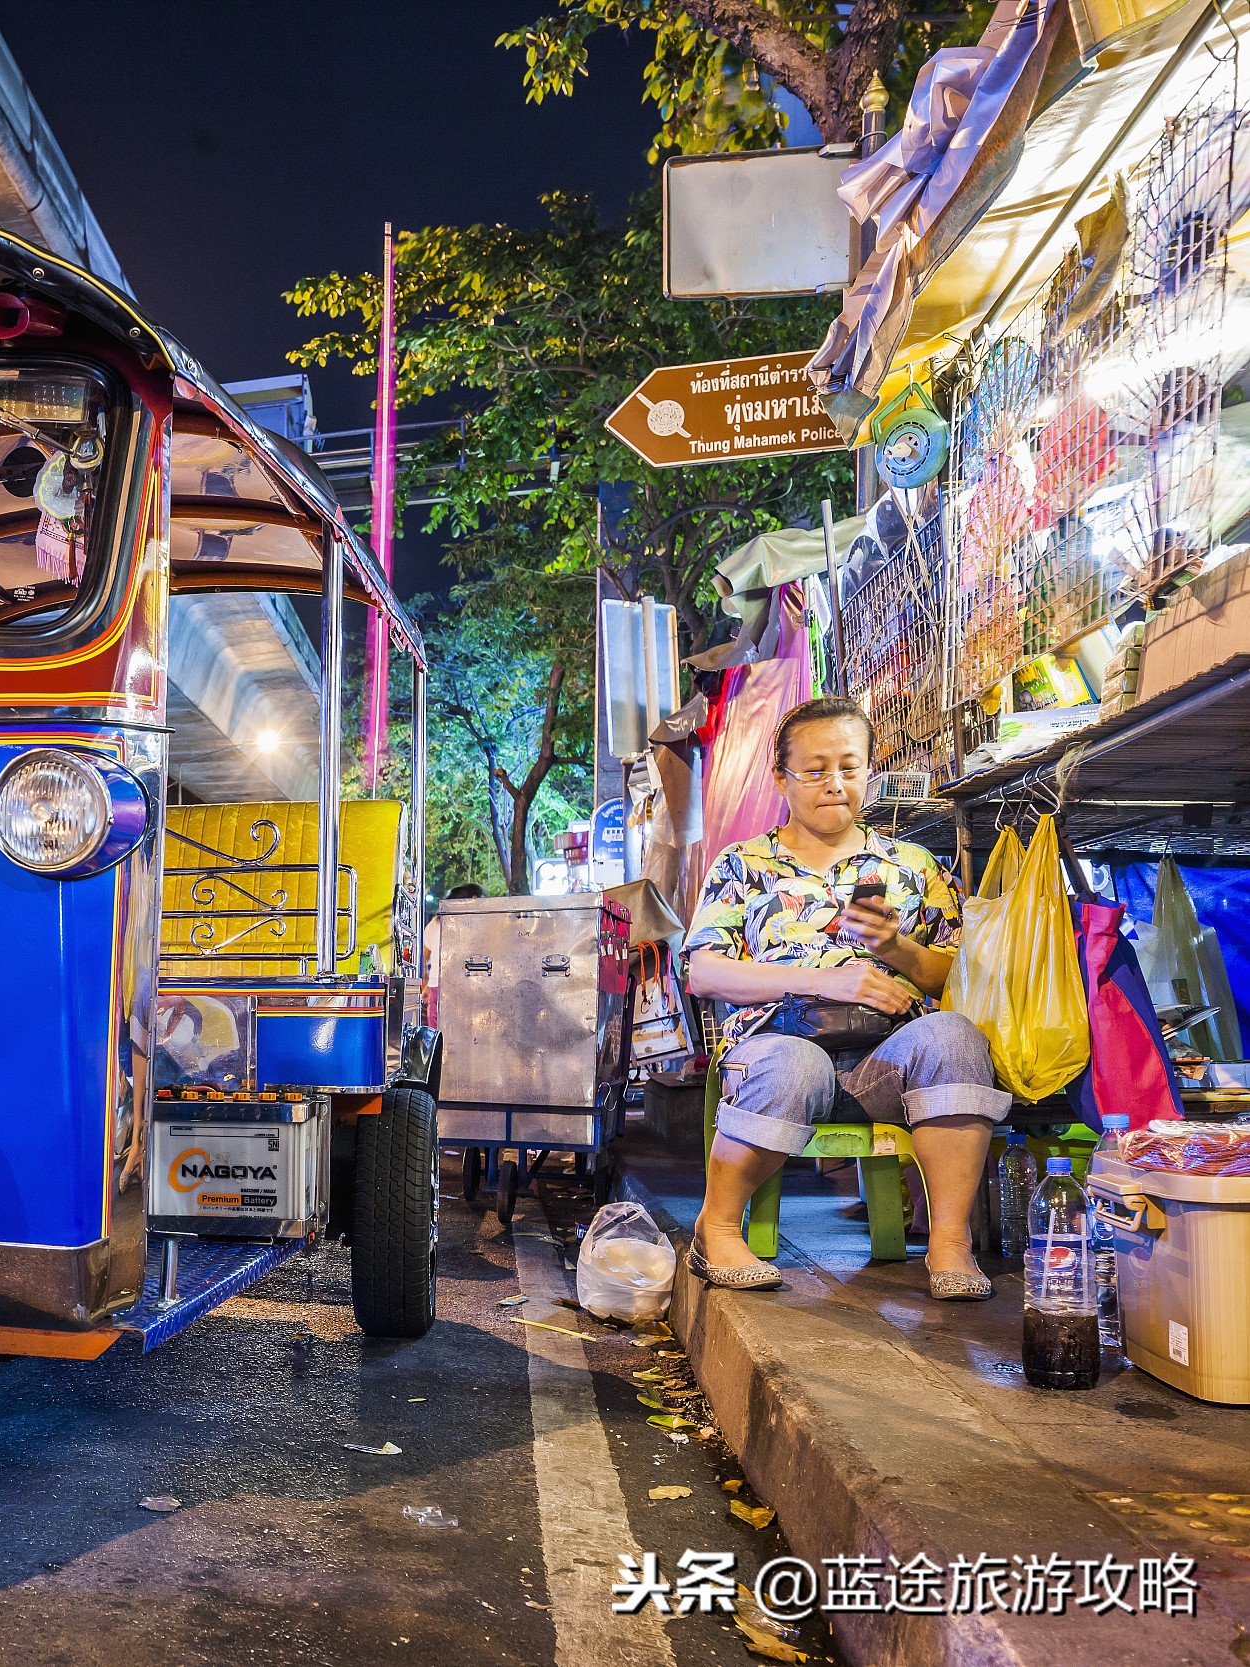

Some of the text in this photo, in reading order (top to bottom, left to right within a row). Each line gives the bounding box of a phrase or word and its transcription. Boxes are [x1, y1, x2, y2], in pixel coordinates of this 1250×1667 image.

[689, 426, 841, 455] Thung Mahamek Police
[181, 1164, 277, 1181] NAGOYA
[202, 1194, 275, 1206] Premium Battery
